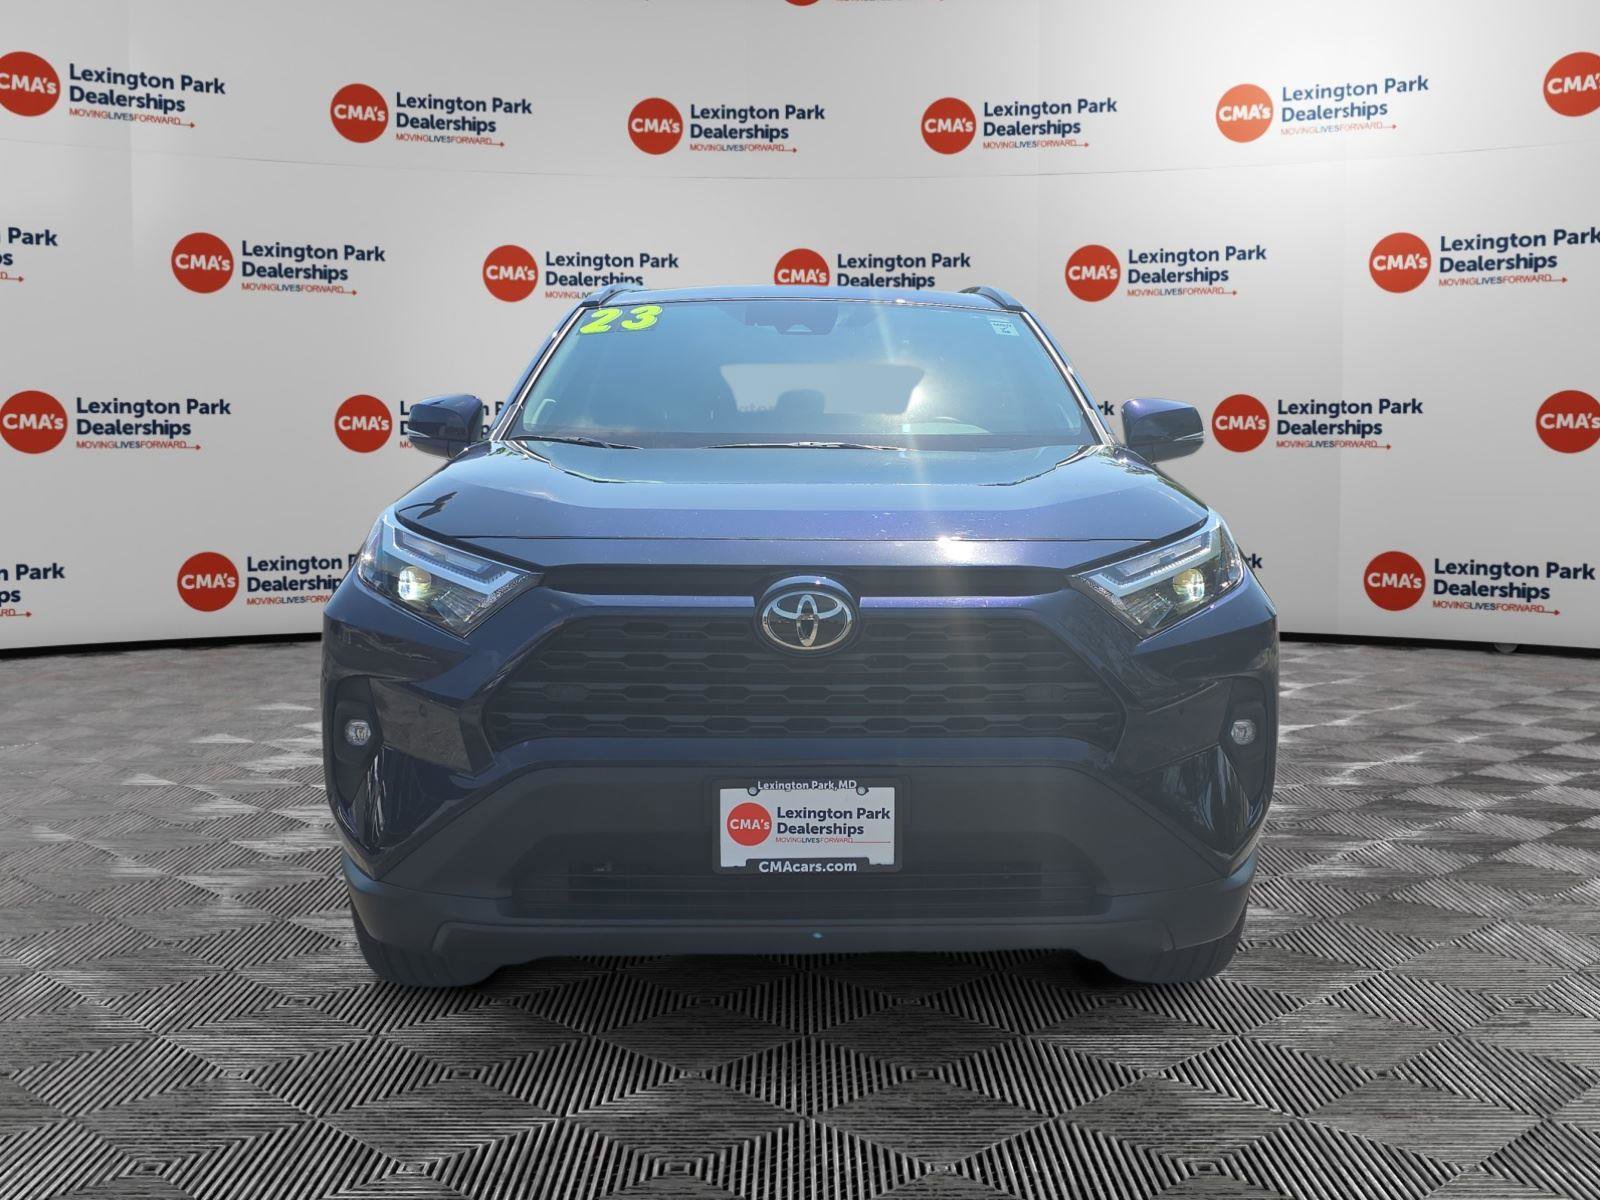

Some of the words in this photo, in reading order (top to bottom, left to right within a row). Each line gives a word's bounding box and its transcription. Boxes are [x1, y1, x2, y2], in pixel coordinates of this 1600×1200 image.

[69, 63, 175, 90] Lexington
[181, 75, 226, 95] Park
[1282, 83, 1378, 103] Lexington
[1384, 75, 1429, 95] Park
[69, 85, 186, 115] Dealerships
[396, 92, 487, 114] Lexington
[491, 97, 533, 115] Park
[983, 101, 1072, 120] Lexington
[1077, 98, 1118, 114] Park
[333, 104, 386, 122] CMA's
[690, 104, 780, 125] Lexington
[784, 104, 826, 120] Park
[1218, 103, 1271, 122] CMA's
[1281, 102, 1389, 123] Dealerships
[396, 112, 497, 135] Dealerships
[631, 119, 681, 134] CMA's
[924, 118, 974, 134] CMA's
[983, 120, 1082, 138] Dealerships
[690, 124, 790, 143] Dealerships
[8, 226, 58, 247] Park
[1440, 233, 1547, 254] Lexington
[1553, 226, 1600, 247] Park
[241, 240, 339, 263] Lexington
[343, 245, 386, 262] Park
[545, 251, 635, 271] Lexington
[639, 253, 680, 269] Park
[1128, 248, 1220, 267] Lexington
[1225, 245, 1267, 261] Park
[175, 253, 231, 272] CMA's
[837, 254, 927, 272] Lexington
[931, 253, 971, 269] Park
[1372, 253, 1429, 272] CMA's
[1439, 253, 1559, 274] Dealerships
[241, 261, 349, 284] Dealerships
[485, 264, 536, 281] CMA's
[777, 268, 827, 284] CMA's
[837, 272, 936, 291] Dealerships
[1067, 264, 1118, 281] CMA's
[1127, 267, 1230, 285] Dealerships
[579, 304, 664, 335] 23
[76, 397, 181, 419] Lexington
[186, 399, 232, 416] Park
[1277, 399, 1373, 419] Lexington
[1378, 398, 1424, 415] Park
[2, 413, 64, 431] CMA's
[76, 419, 192, 439] Dealerships
[338, 415, 390, 431] CMA's
[1215, 414, 1267, 431] CMA's
[1276, 419, 1383, 439] Dealerships
[1540, 413, 1600, 430] CMA's
[15, 562, 66, 581] Park
[246, 556, 343, 575] Lexington
[1434, 557, 1539, 580] Lexington
[1545, 561, 1596, 581] Park
[181, 573, 236, 590] CMA's
[1367, 572, 1422, 589] CMA's
[1433, 579, 1551, 603] Dealerships
[757, 780, 809, 792] Lexington
[776, 806, 853, 822] Lexington
[856, 807, 891, 820] Park
[729, 818, 771, 831] CMA's
[776, 822, 865, 838] Dealerships
[758, 860, 857, 873] CMAcars.com
